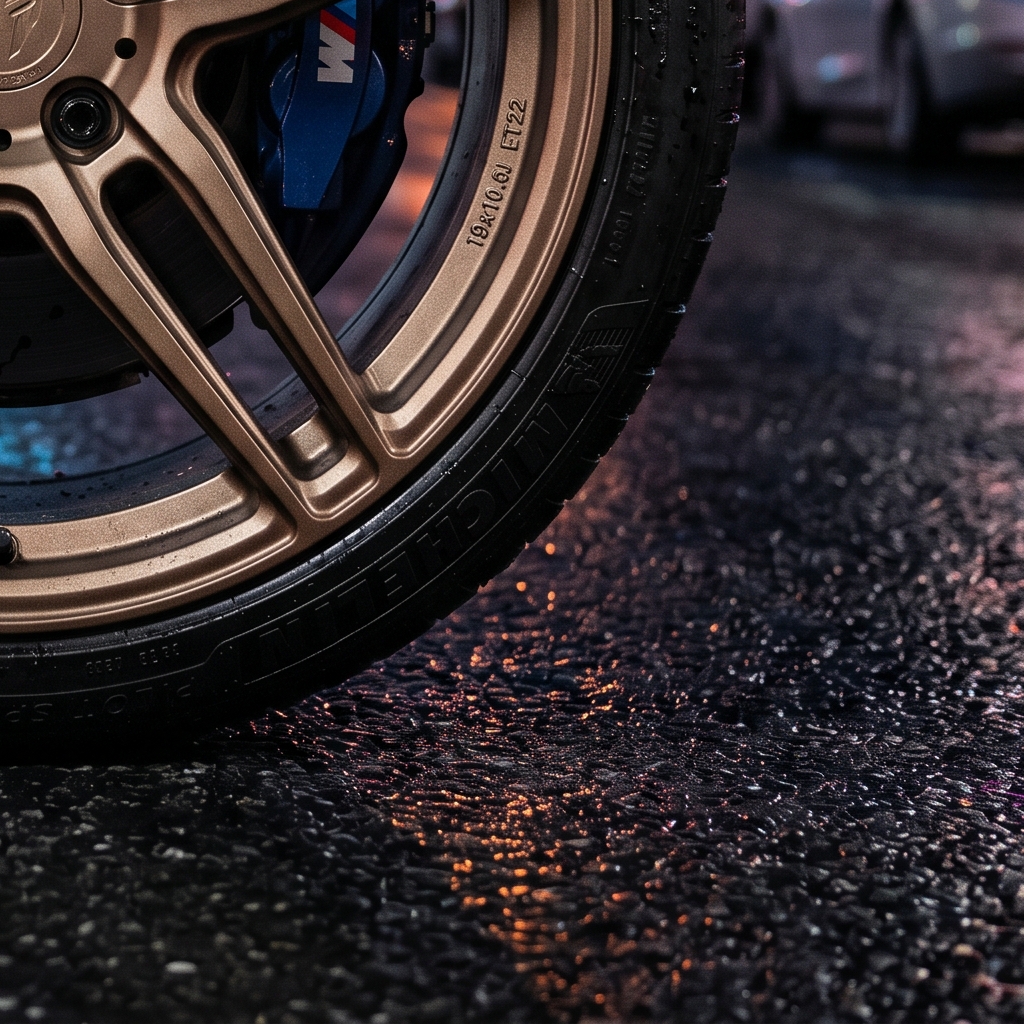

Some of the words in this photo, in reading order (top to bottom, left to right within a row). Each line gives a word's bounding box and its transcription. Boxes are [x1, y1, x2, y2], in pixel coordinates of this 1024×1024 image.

[316, 21, 356, 84] M
[499, 97, 528, 152] ET22
[252, 402, 570, 670] MICHELIN
